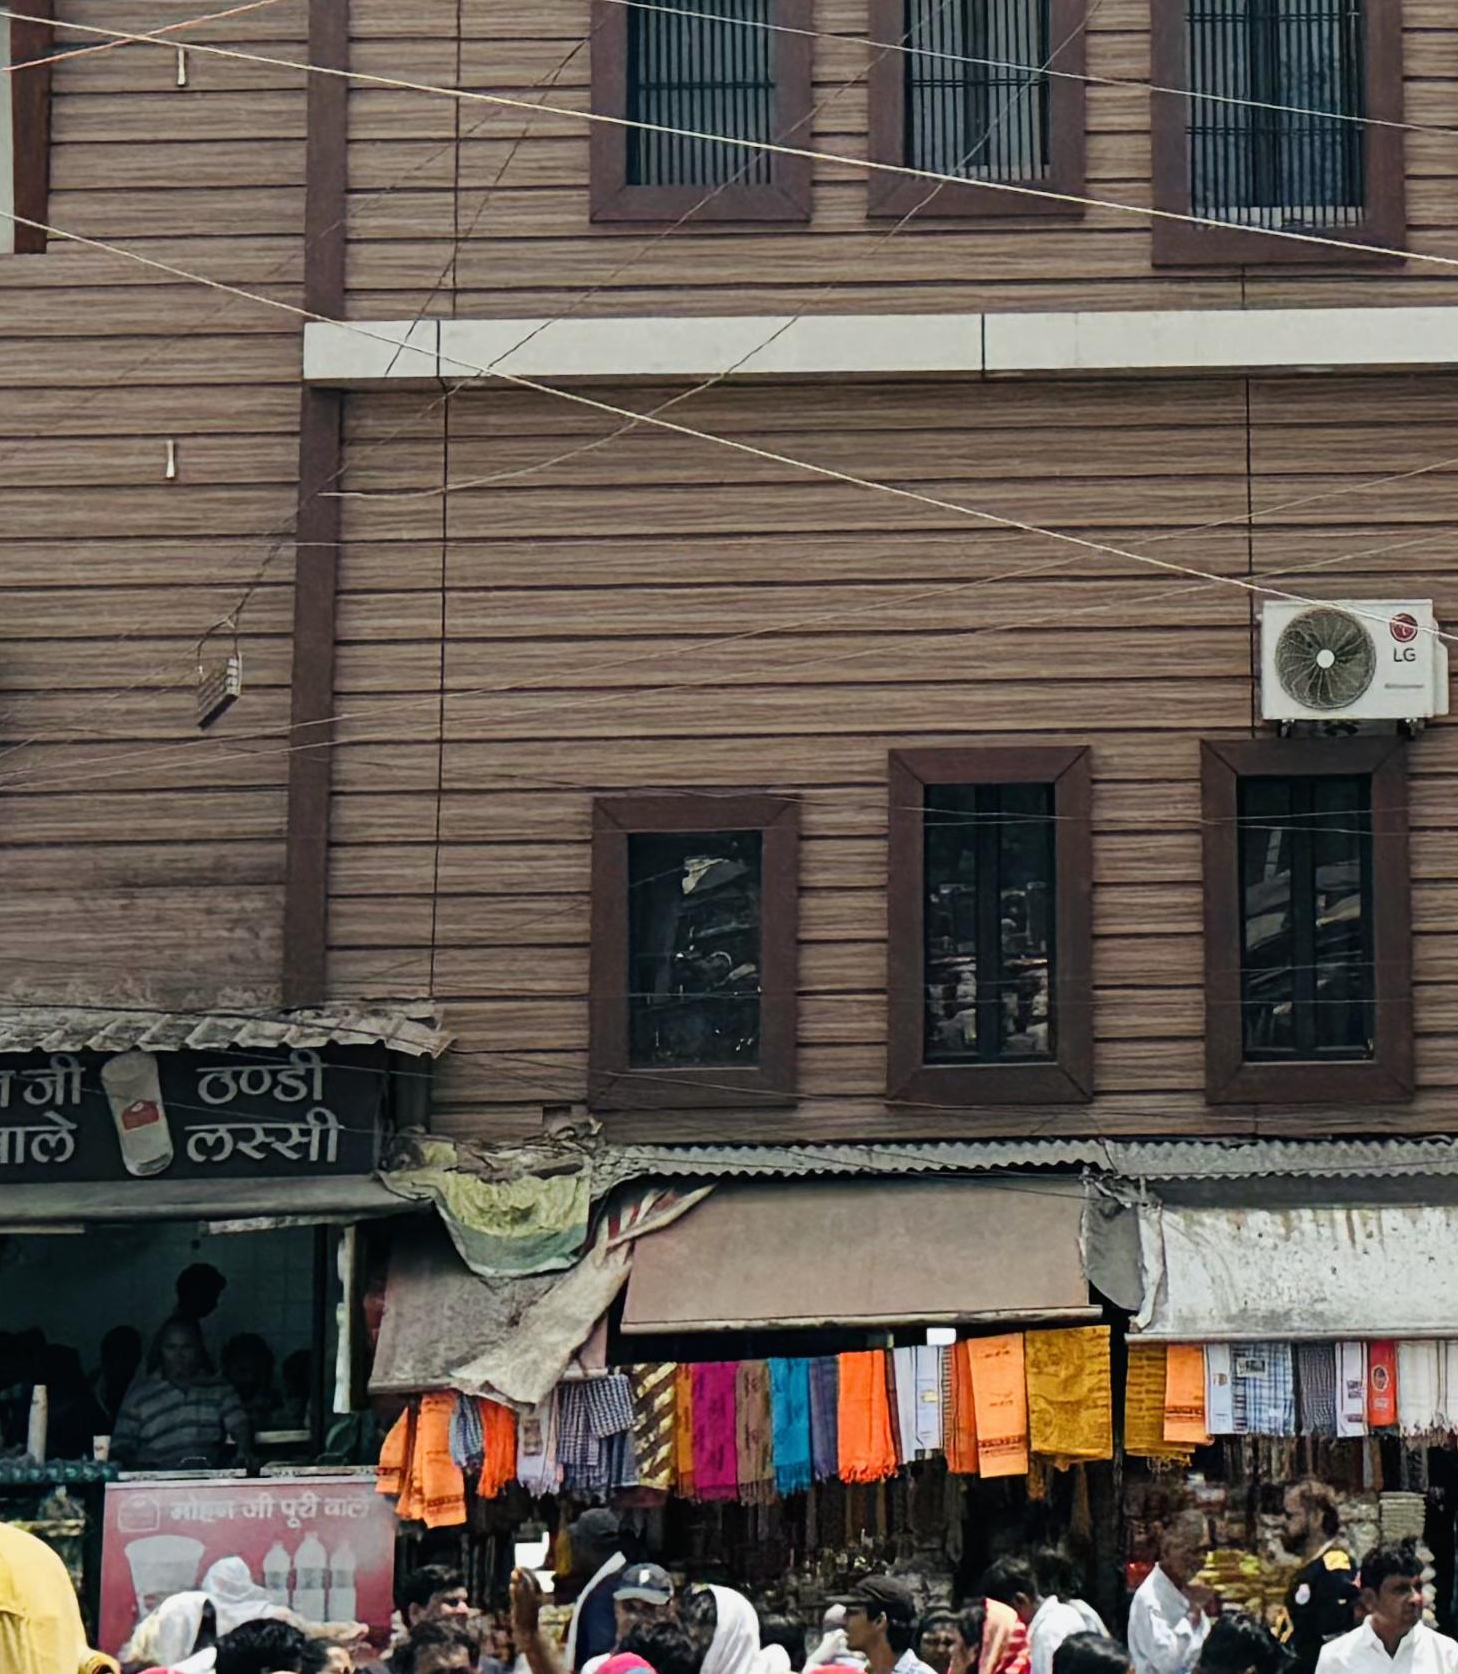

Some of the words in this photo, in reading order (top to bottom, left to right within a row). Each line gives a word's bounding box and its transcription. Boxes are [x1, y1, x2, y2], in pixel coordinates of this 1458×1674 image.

[1393, 647, 1416, 663] LG
[22, 1053, 86, 1106] जी
[184, 1107, 345, 1163] लस्सी
